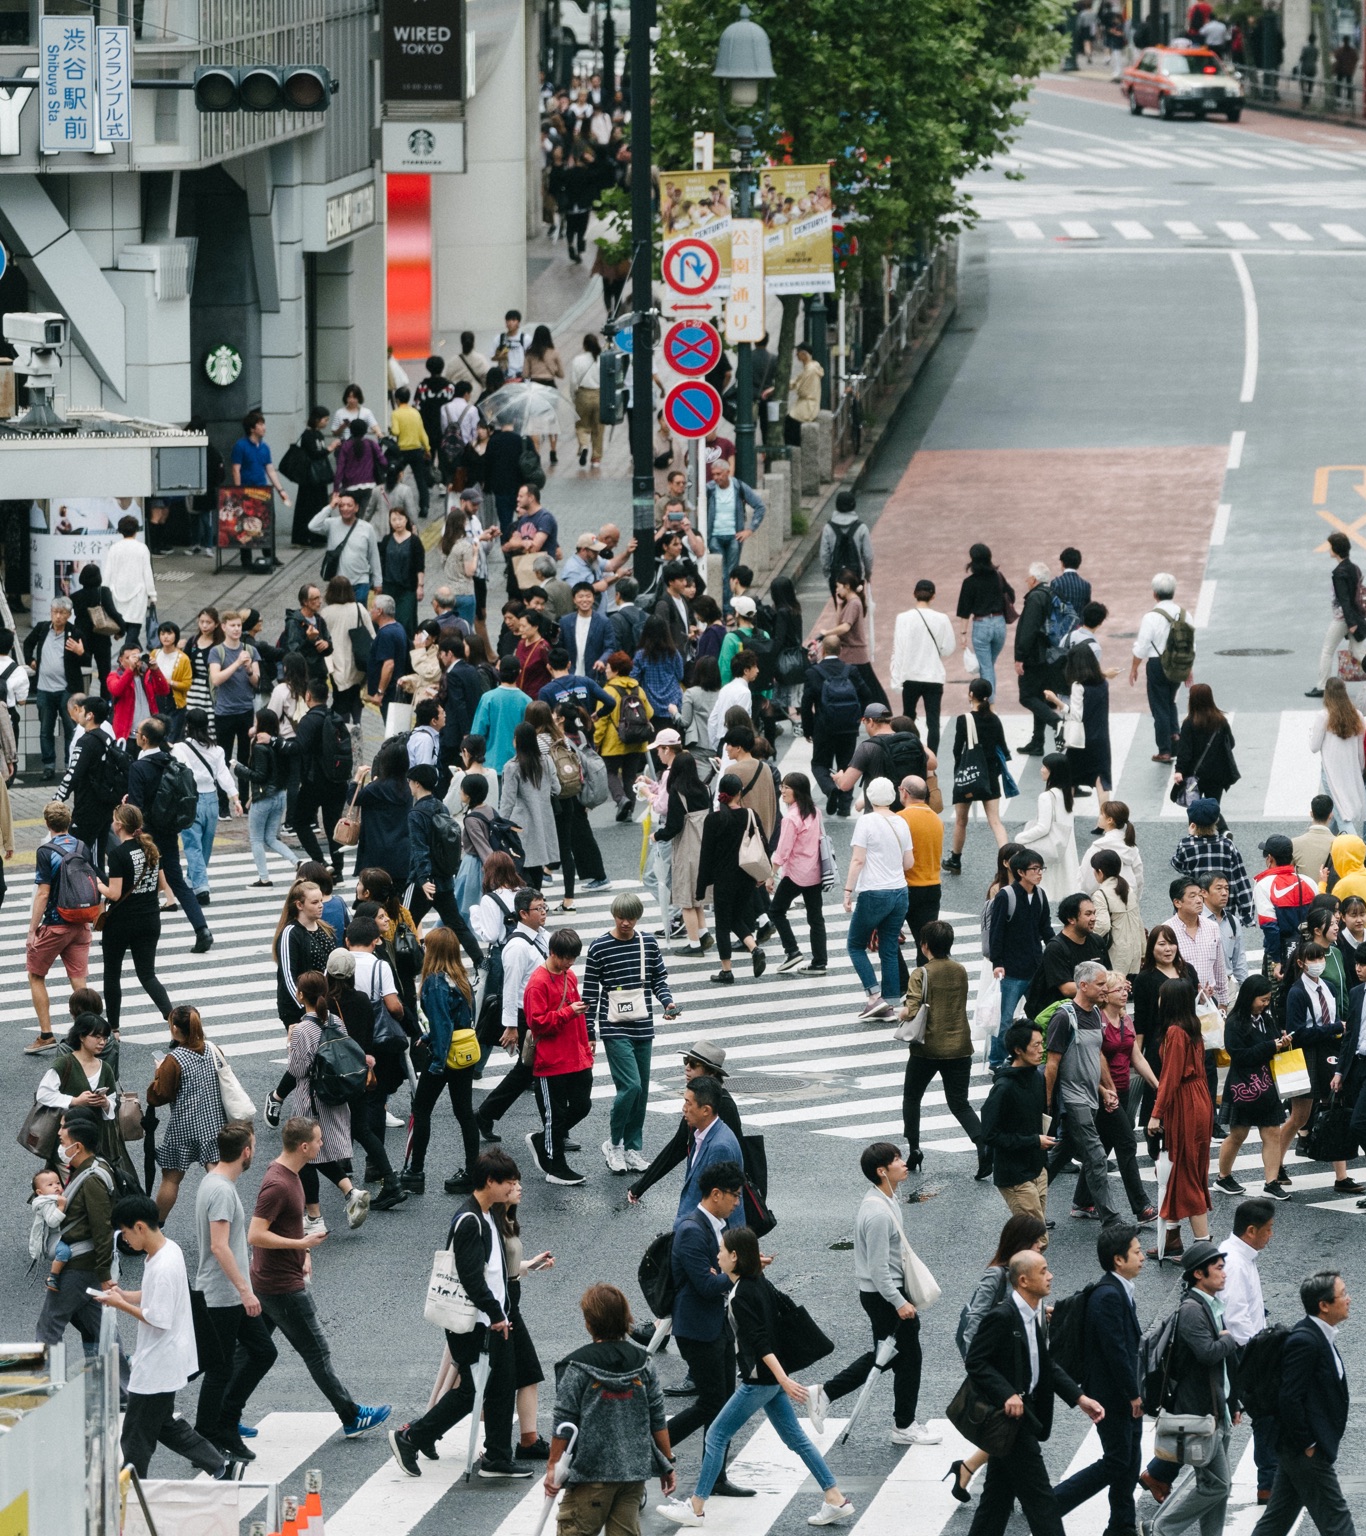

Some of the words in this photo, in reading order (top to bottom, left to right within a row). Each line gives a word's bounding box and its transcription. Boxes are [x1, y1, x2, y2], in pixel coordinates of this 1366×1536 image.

[393, 26, 452, 42] WIRED
[401, 43, 444, 55] TOKYO
[46, 44, 60, 96] Shibuya
[63, 28, 87, 140] 渋谷駅前
[105, 31, 124, 137] スクランブル式
[48, 100, 60, 126] Sta.
[732, 229, 749, 330] 公園通り
[618, 1003, 632, 1012] Lee
